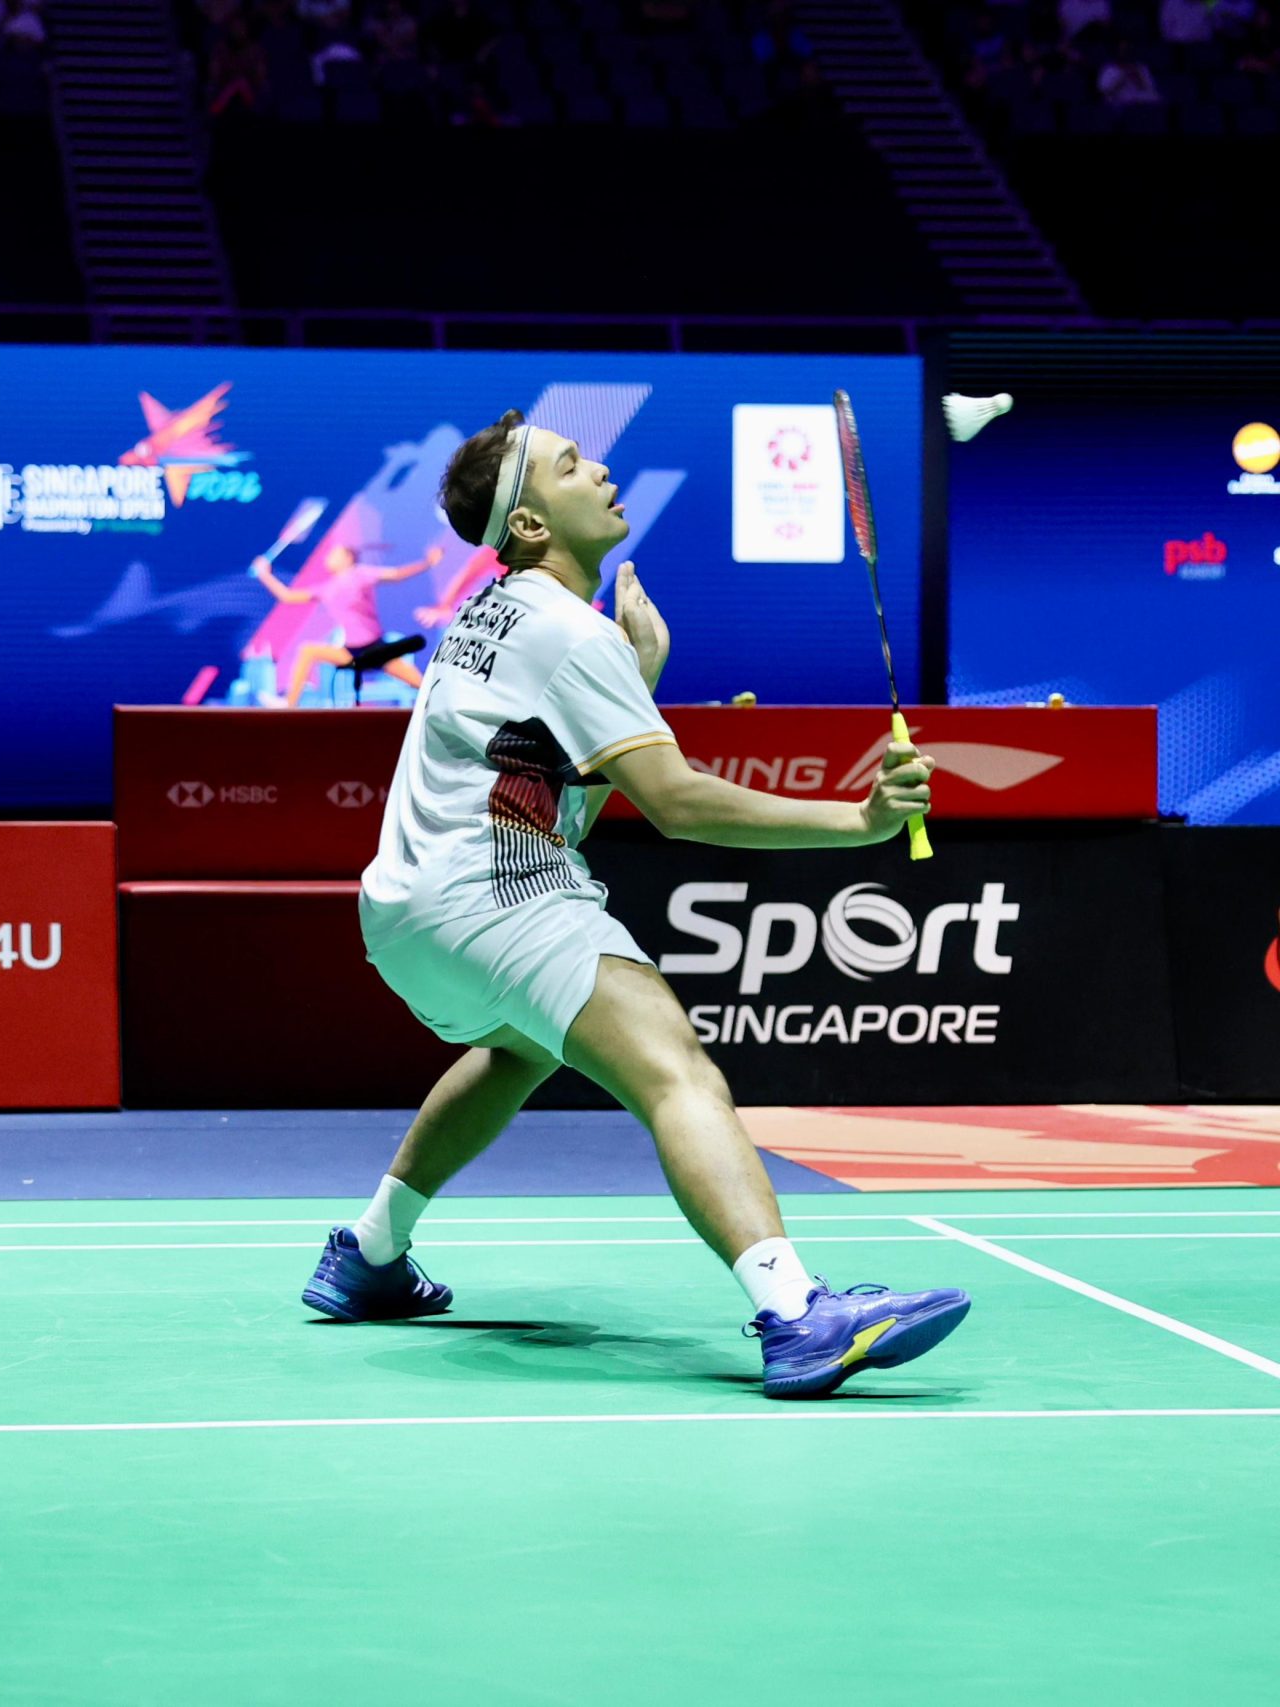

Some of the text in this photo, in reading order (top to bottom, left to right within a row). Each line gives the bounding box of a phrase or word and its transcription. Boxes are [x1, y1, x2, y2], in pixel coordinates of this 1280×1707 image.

[22, 465, 164, 498] SINGAPORE
[1164, 532, 1227, 575] psb
[221, 786, 278, 803] HSBC
[660, 882, 1020, 995] Sport
[687, 1005, 1001, 1045] SINGAPORE
